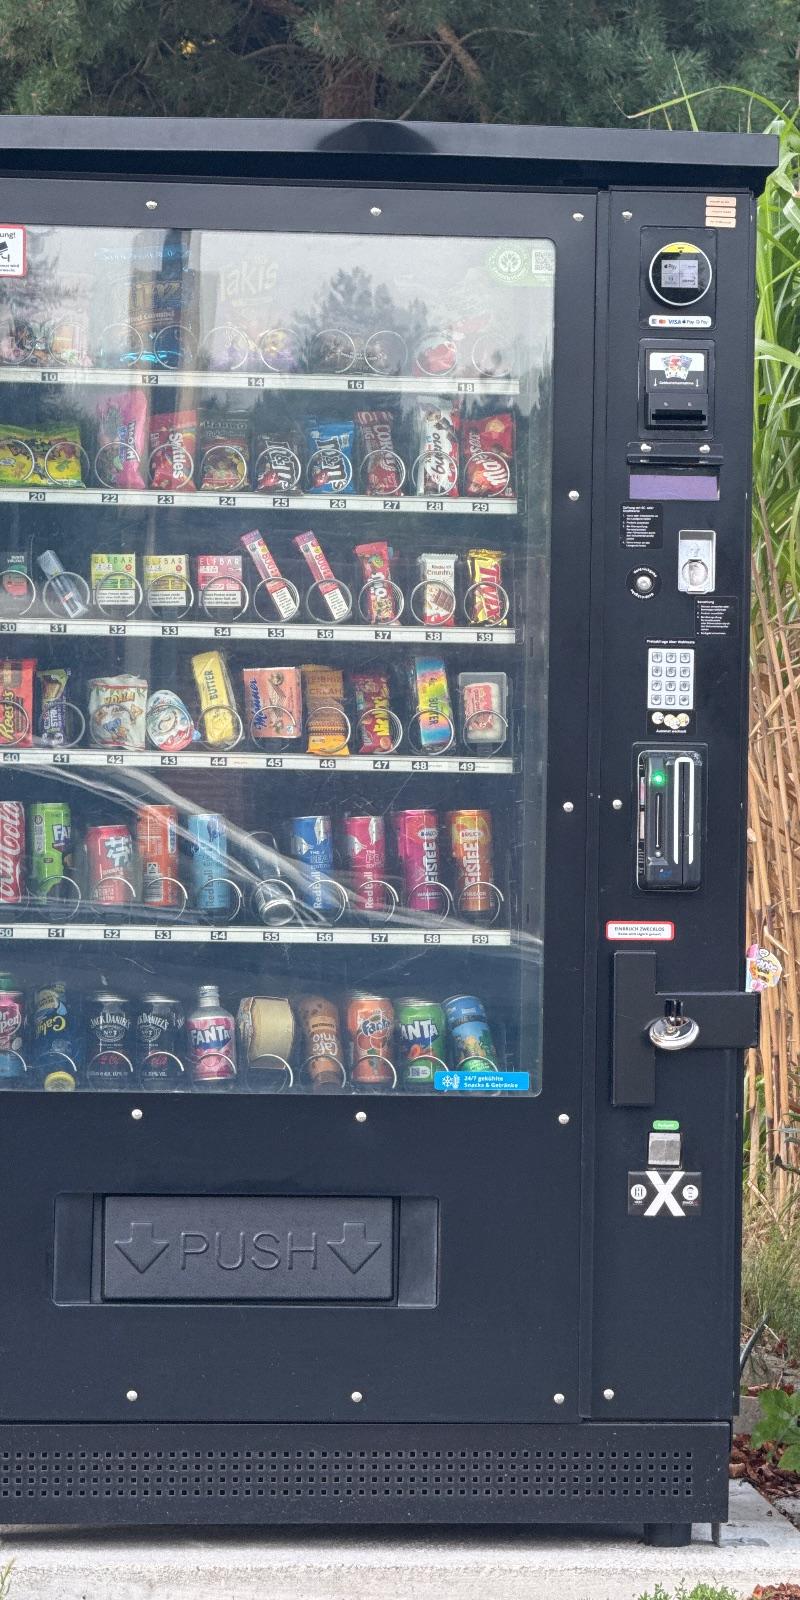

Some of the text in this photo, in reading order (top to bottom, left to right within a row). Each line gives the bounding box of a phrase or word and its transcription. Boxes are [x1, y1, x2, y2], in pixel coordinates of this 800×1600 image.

[43, 373, 57, 381] 10
[143, 376, 157, 384] 12
[249, 378, 263, 386] 14
[169, 432, 186, 479] Skittles
[205, 670, 218, 700] BUTTER
[429, 696, 438, 726] BUTTER
[423, 842, 438, 882] EISTEE
[464, 840, 480, 890] EISTEE
[365, 892, 373, 908] Red
[191, 1026, 230, 1046] FANTA
[361, 1019, 390, 1036] Fanta
[180, 1231, 318, 1271] PUSH
